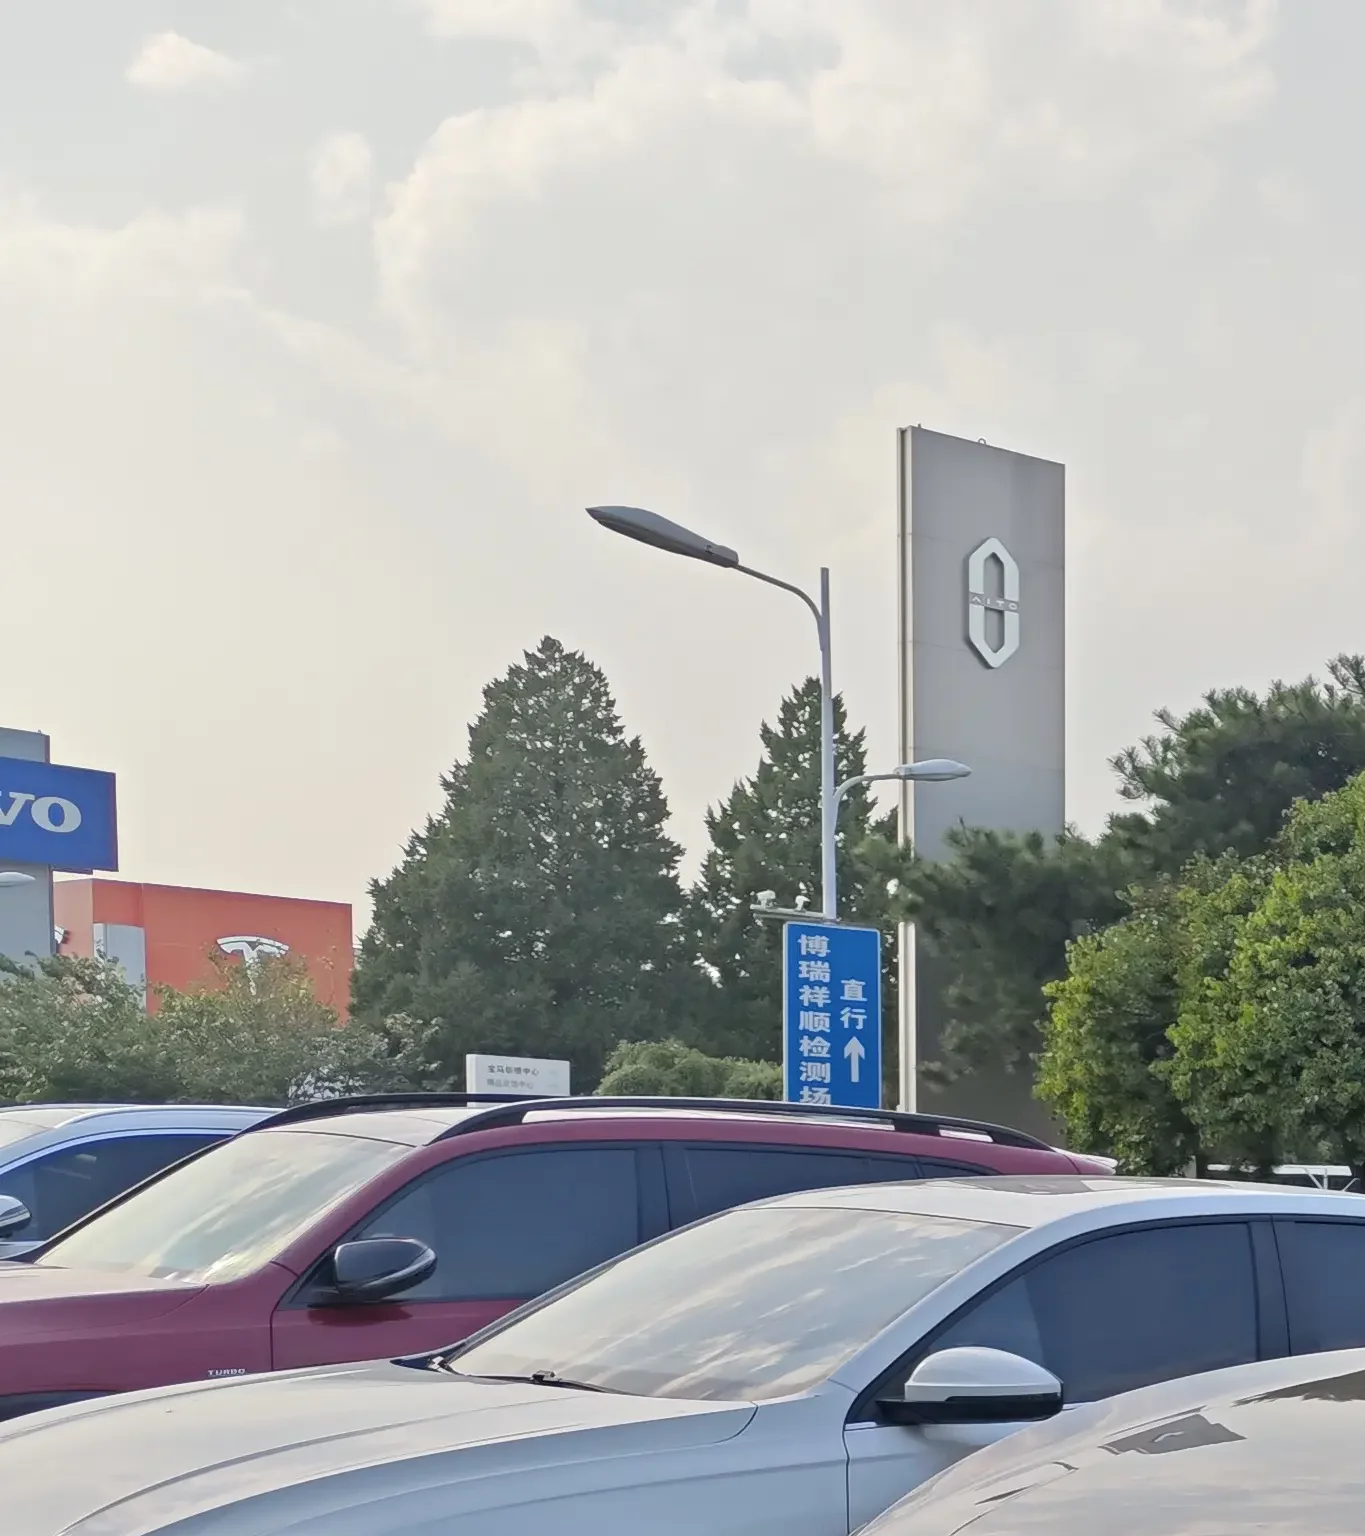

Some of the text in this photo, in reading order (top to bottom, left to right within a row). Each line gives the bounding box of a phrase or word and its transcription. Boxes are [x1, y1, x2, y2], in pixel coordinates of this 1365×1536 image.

[797, 934, 832, 1105] 博瑞祥顺检测场
[840, 979, 868, 1030] 直行
[207, 1368, 246, 1376] TURBO
